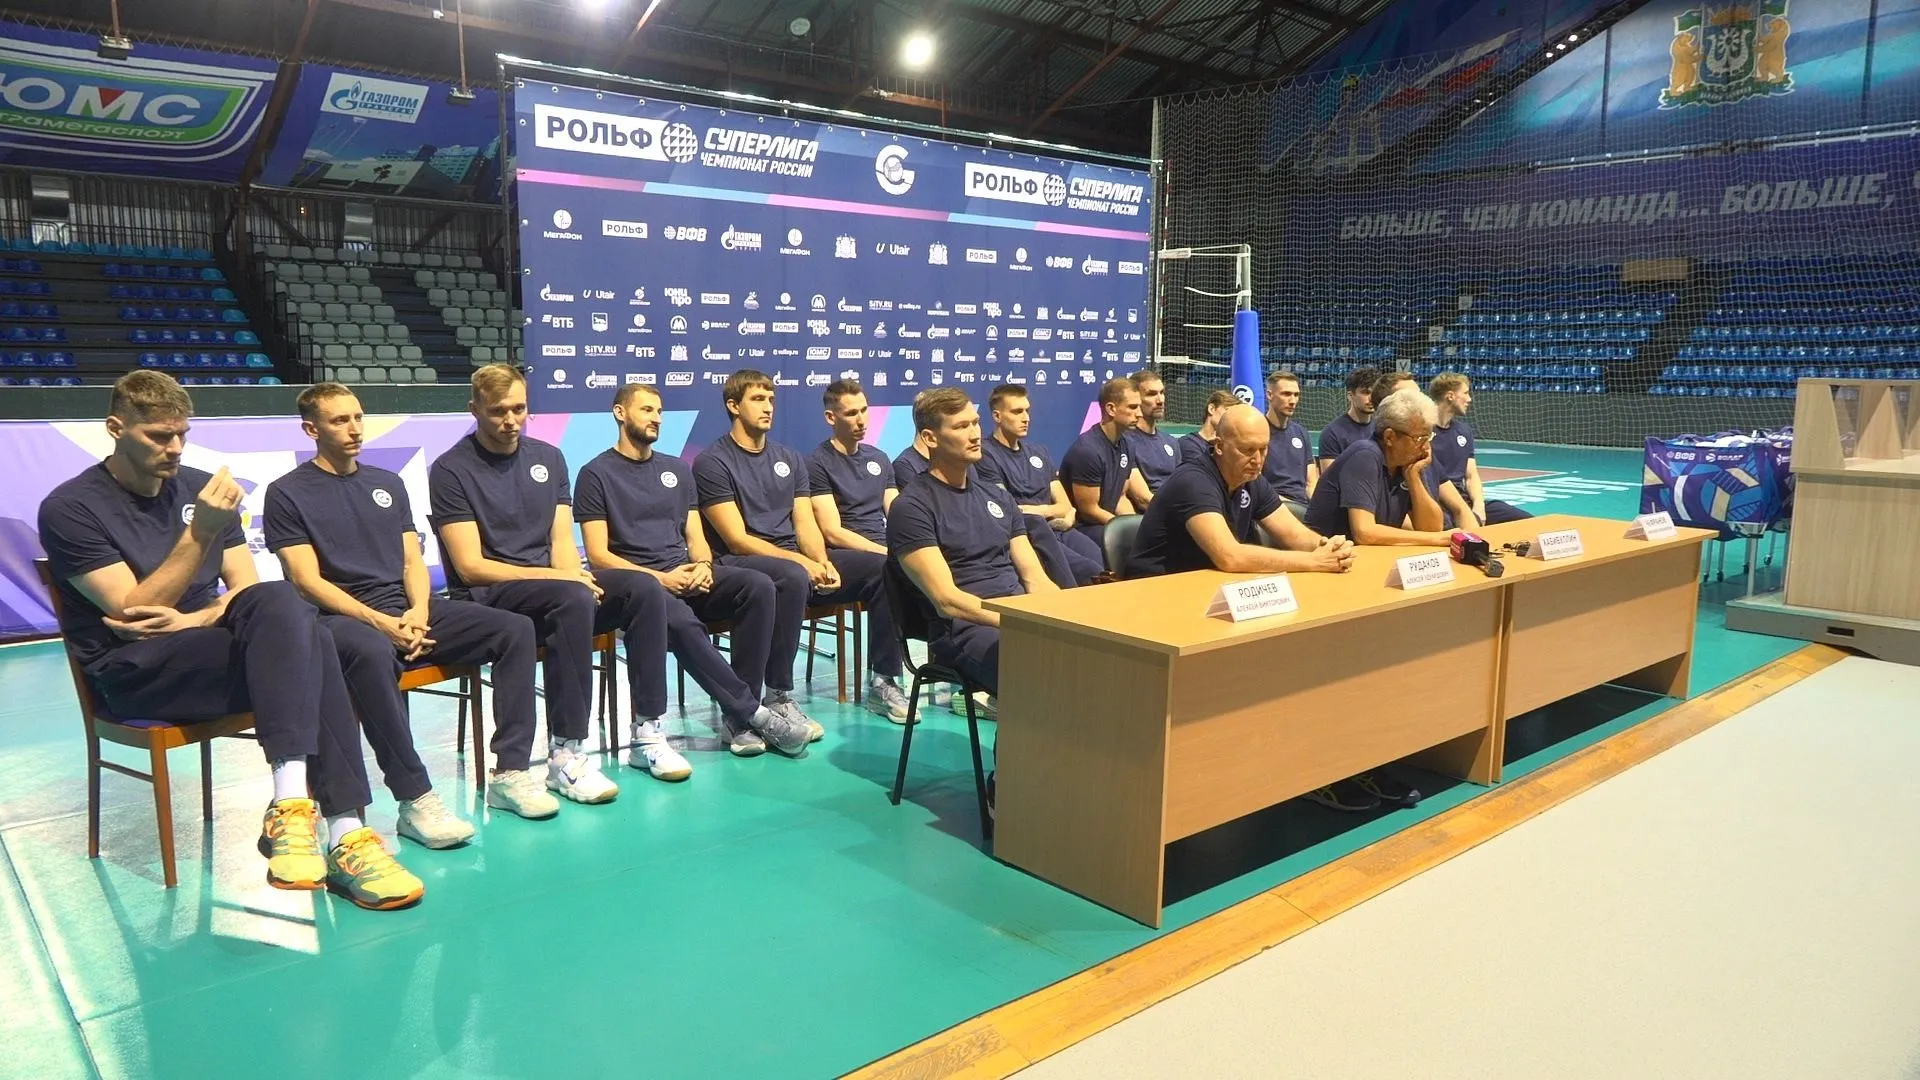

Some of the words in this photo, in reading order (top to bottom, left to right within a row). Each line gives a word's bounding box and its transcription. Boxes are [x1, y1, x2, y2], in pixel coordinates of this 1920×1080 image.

[360, 91, 419, 109] ГАЗПРОМ
[547, 115, 652, 149] РОЛЬФ
[704, 127, 819, 162] СУПЕРЛИГА
[700, 152, 768, 173] ЧЕМПИОНАТ
[770, 161, 814, 178] РОССИИ
[972, 171, 1038, 196] РОЛЬФ
[1070, 177, 1144, 204] СУПЕРЛИГА
[1066, 197, 1111, 214] ЧЕМПИОНАТ
[1110, 202, 1139, 216] РОССИИ
[1339, 209, 1451, 240] БОЛЬШЕ,
[1463, 203, 1521, 231] ЧЕМ
[1720, 173, 1894, 214] БОЛЬШЕ,
[606, 223, 644, 235] РОЛЬФ
[675, 226, 708, 242] ВФВ
[889, 244, 910, 256] Utair
[969, 252, 995, 260] РОЛЬФ
[1053, 256, 1073, 269] ВФВ
[1120, 264, 1142, 272] РОЛЬФ
[595, 290, 616, 300] Utair
[703, 295, 727, 303] РОЛЬФ
[552, 316, 574, 329] ВТБ
[845, 325, 862, 335] ВТБ
[1062, 330, 1075, 340] ВТБ
[584, 345, 617, 354] SiTV.RU
[635, 346, 656, 358] ВТБ
[905, 350, 921, 360] ВТБ
[1106, 352, 1119, 362] ВТБ
[960, 373, 975, 383] ВТБ
[1408, 557, 1441, 573] РУДАКОВ
[1237, 582, 1279, 599] РОДИЧЕВ
[1236, 602, 1258, 613] АЛЕКСЕЙ
